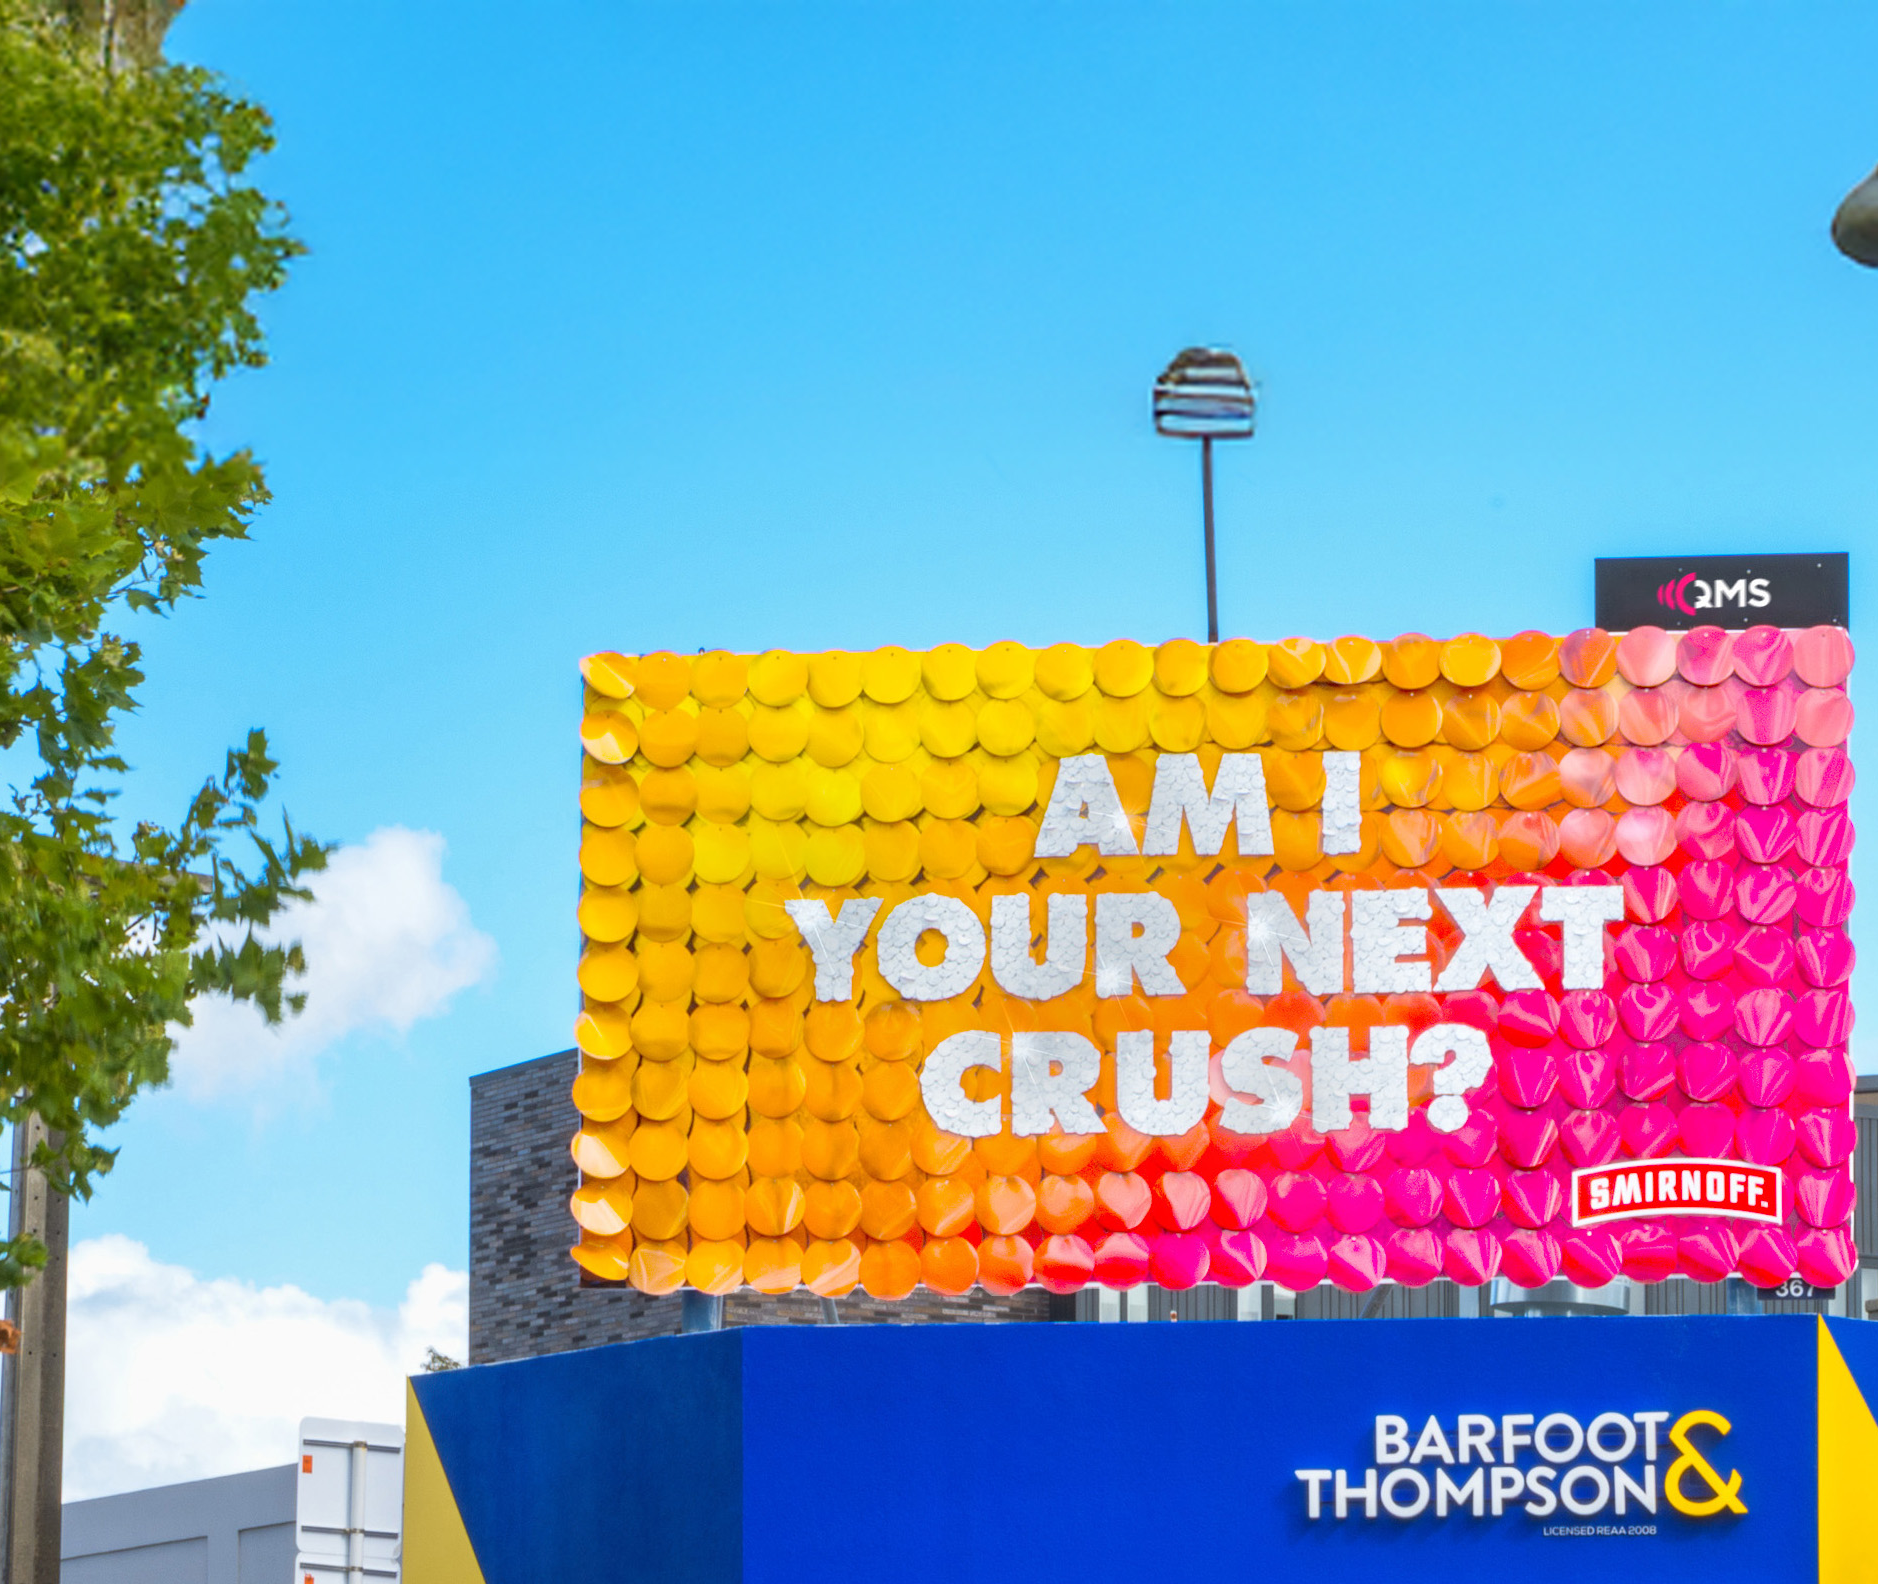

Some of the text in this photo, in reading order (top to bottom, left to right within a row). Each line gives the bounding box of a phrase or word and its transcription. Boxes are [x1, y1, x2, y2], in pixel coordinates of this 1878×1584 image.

[1675, 570, 1771, 614] QMS
[1034, 750, 1361, 857] AM I
[783, 884, 1625, 1004] YOUR NEXT
[920, 1022, 1493, 1139] CRUSH?
[1294, 1465, 1657, 1518] THOMPSON
[1375, 1409, 1749, 1516] BARFOOT &
[1543, 1525, 1658, 1537] LICENSED REAA 2008
